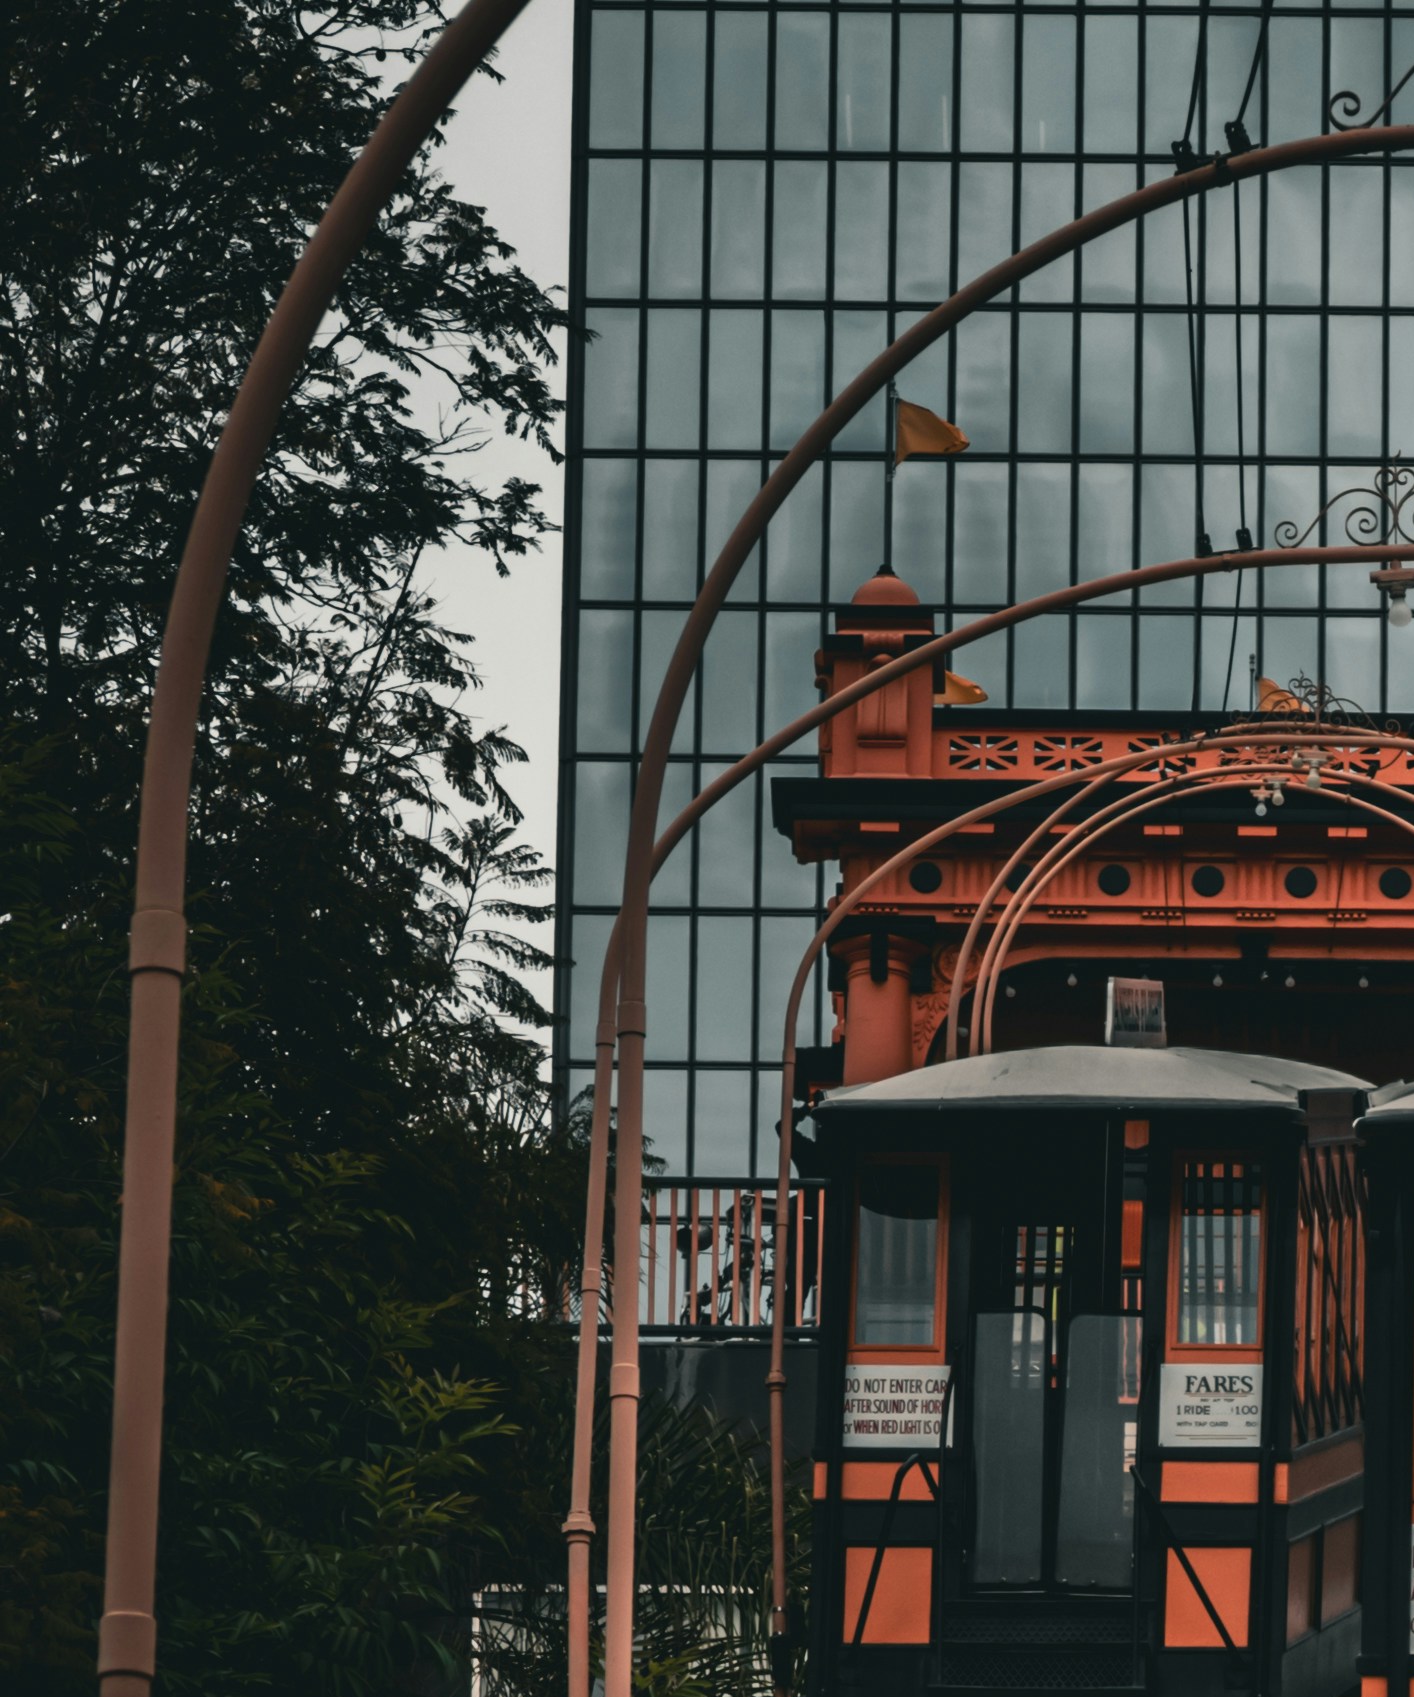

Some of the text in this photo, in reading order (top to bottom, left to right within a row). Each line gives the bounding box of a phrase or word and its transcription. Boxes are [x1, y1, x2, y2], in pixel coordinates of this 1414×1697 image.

[845, 1378, 947, 1394] DO NOT ENTER CAR
[1185, 1375, 1254, 1394] FARES
[843, 1399, 943, 1414] AFTER SOUND OF HOR
[1176, 1405, 1181, 1415] 1
[1183, 1405, 1211, 1415] RIDE
[853, 1420, 880, 1434] WHEN
[881, 1420, 898, 1434] RED
[899, 1420, 922, 1434] LIGHT
[923, 1420, 932, 1434] IS
